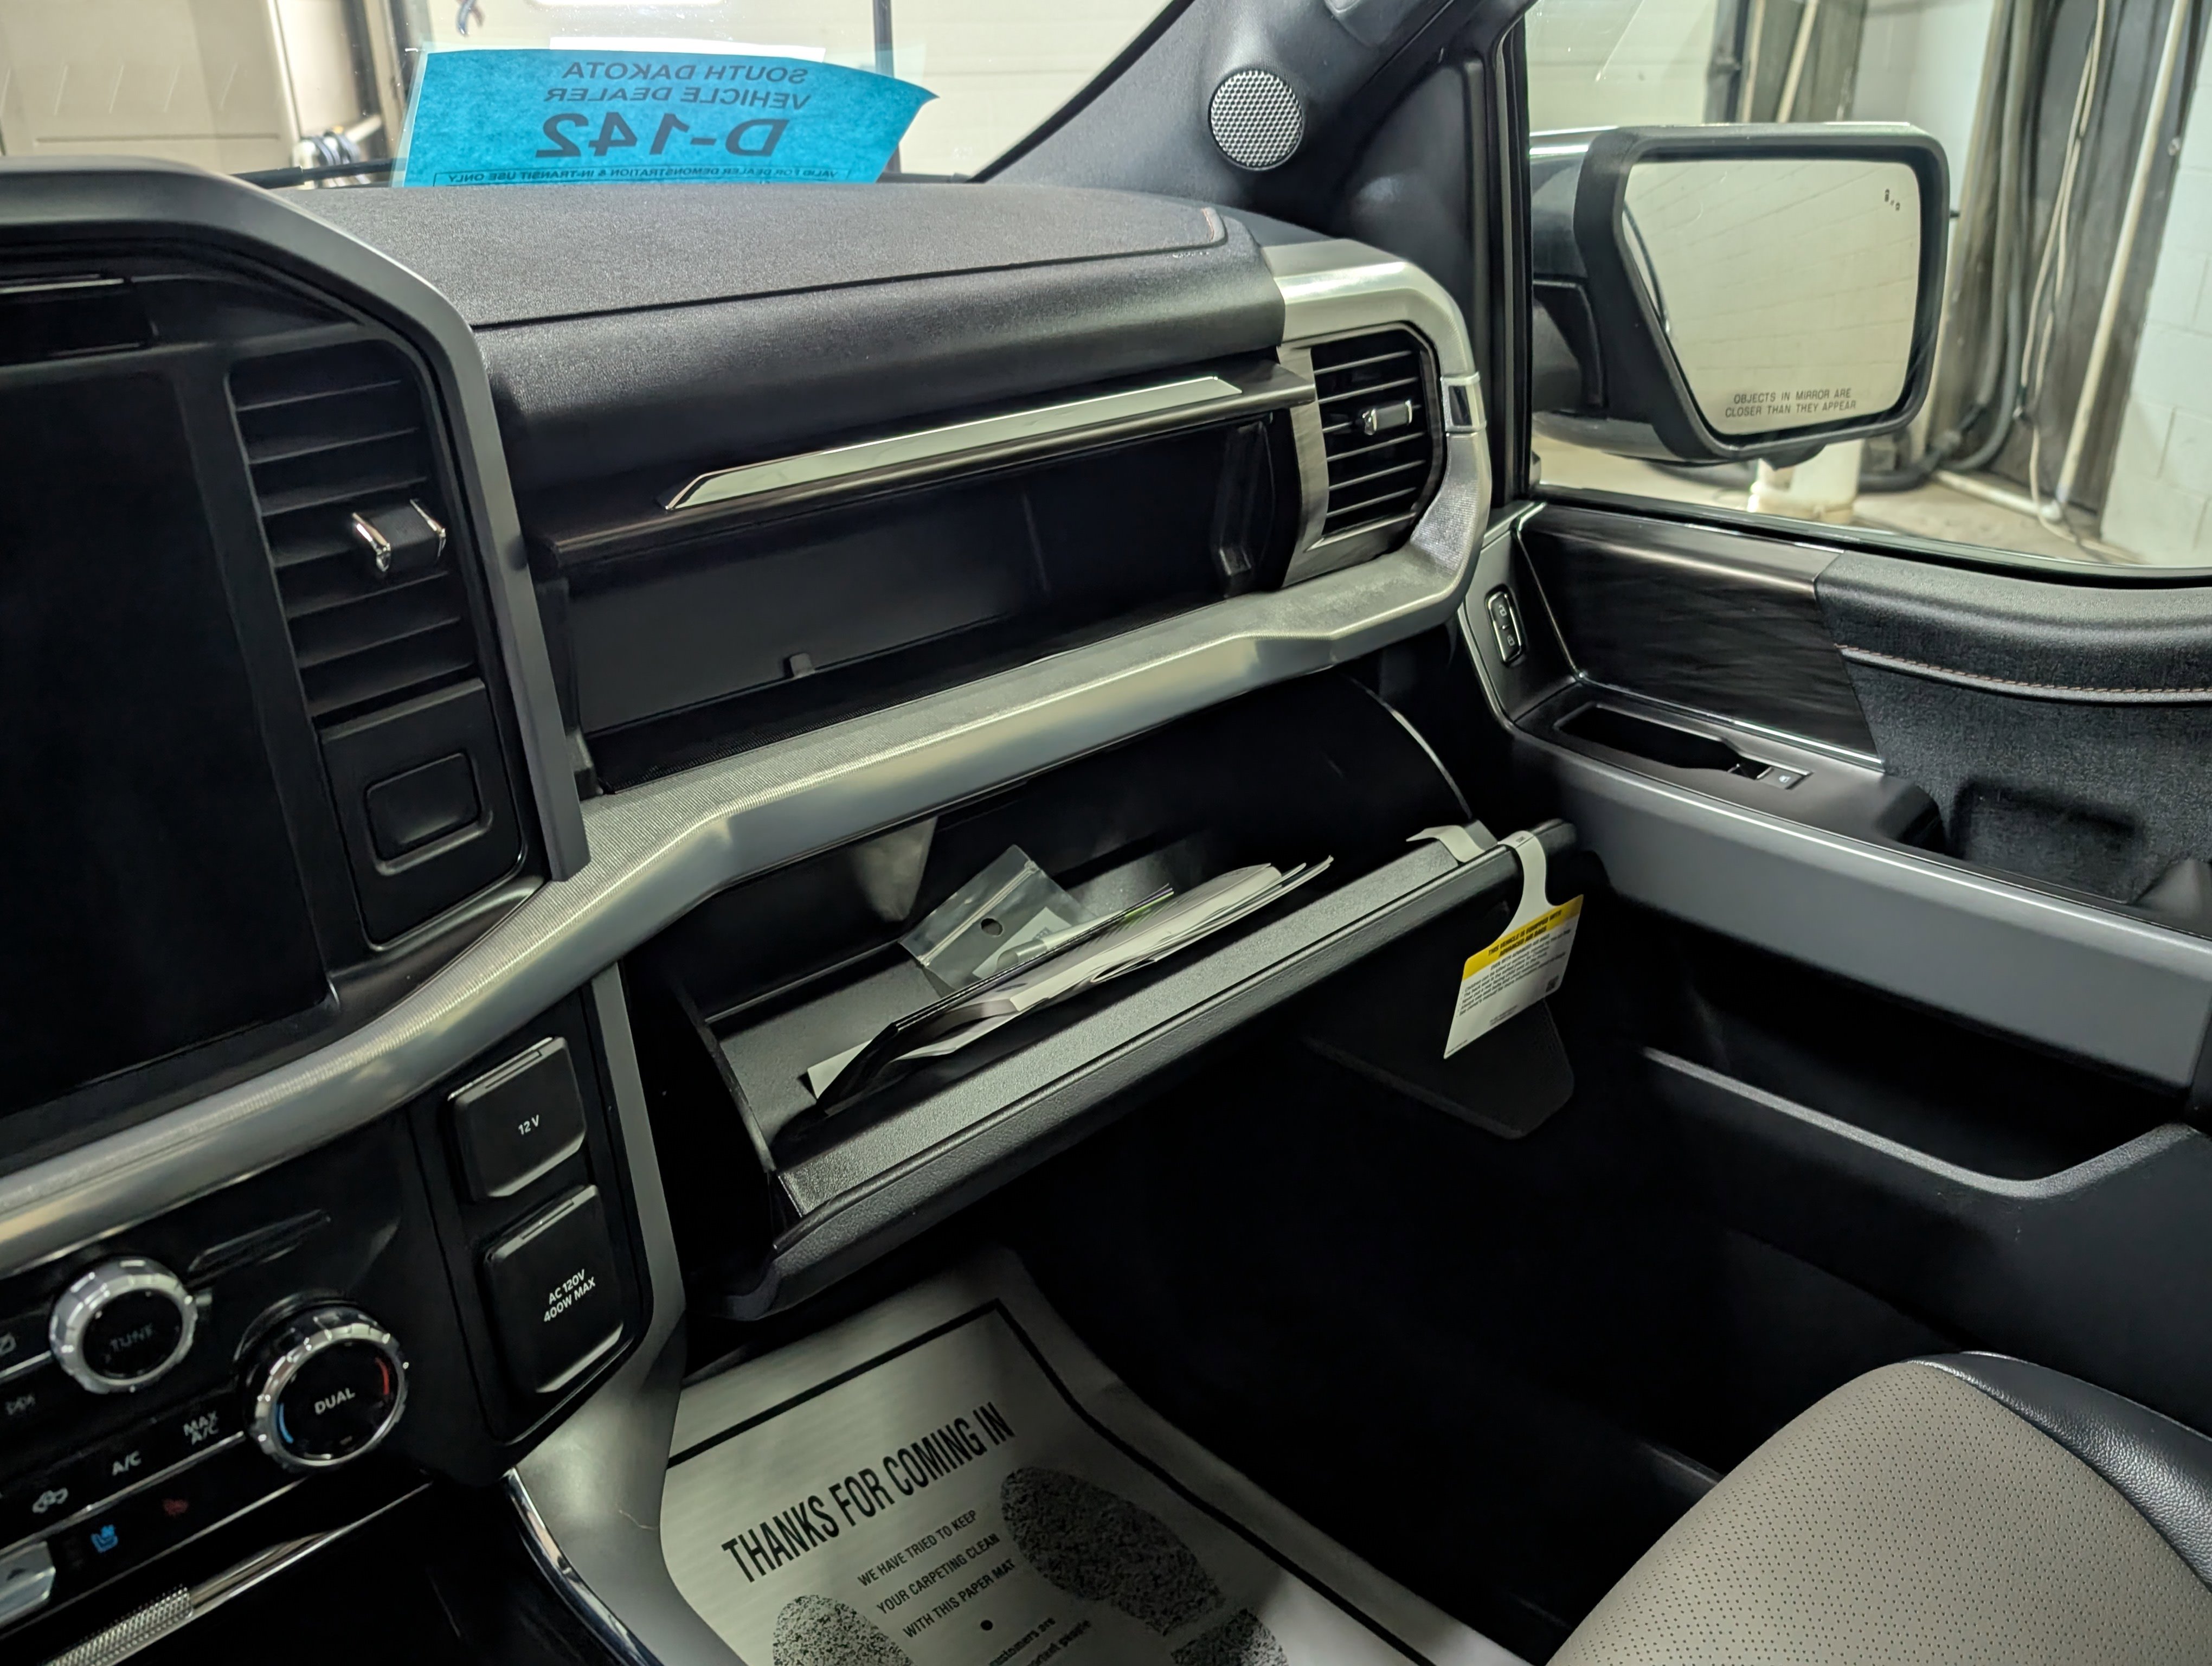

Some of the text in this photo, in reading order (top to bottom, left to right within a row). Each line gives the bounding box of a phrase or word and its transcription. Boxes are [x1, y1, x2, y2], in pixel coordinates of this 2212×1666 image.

[1725, 400, 1857, 418] CLOSER THAN THEY APPEAR
[1733, 387, 1851, 405] OBJECTS IN MIRROR ARE
[518, 1114, 539, 1136] 12 V
[544, 1276, 596, 1322] 400W MAX
[549, 1268, 585, 1305] AC 120V
[314, 1388, 356, 1414] DUAL
[183, 1411, 218, 1437] MAX
[191, 1424, 219, 1445] A/C
[112, 1450, 142, 1476] A/C
[721, 1401, 1016, 1583] THANKS FOR COMING IN
[857, 1509, 976, 1586] WE HAVE TRIED TO KEEP
[876, 1533, 1000, 1614] YOUR CARPETING CLEAN
[902, 1558, 1015, 1638] WITH THIS PAPER MAT
